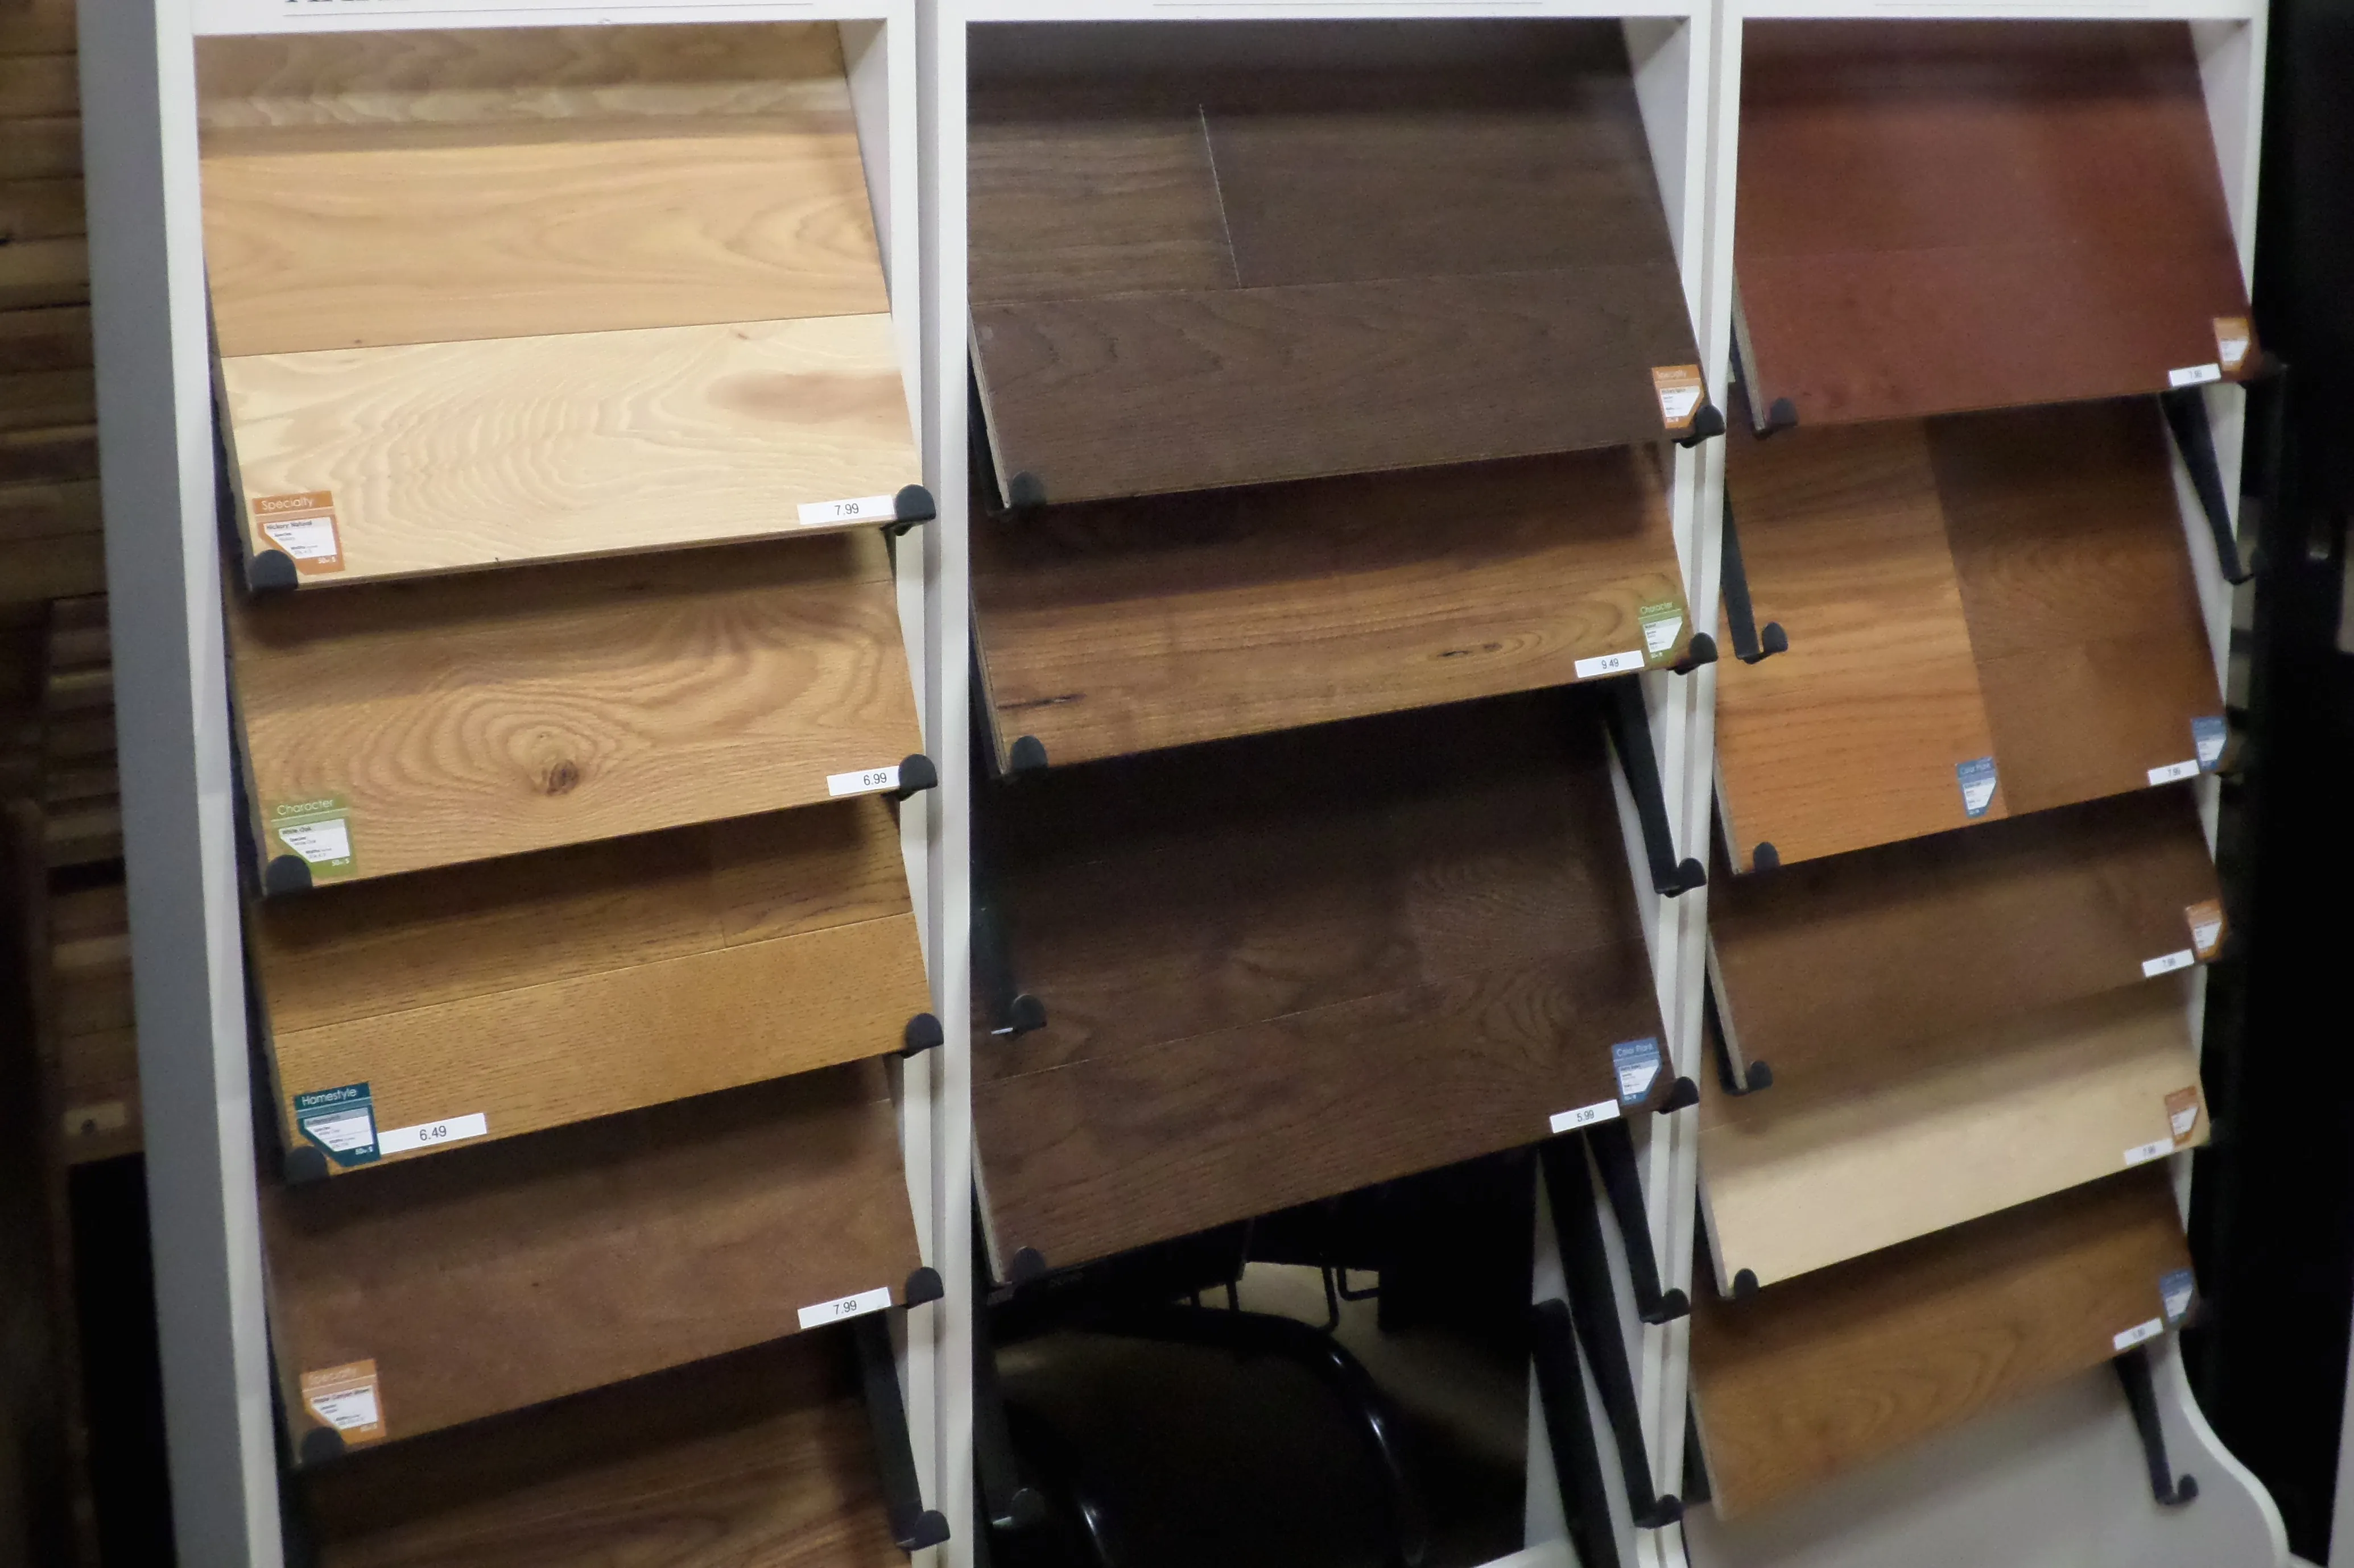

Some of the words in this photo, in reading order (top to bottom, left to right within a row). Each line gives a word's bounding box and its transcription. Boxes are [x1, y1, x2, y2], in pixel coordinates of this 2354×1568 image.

[261, 497, 314, 511] Specialty
[834, 503, 859, 516] 7.99
[1601, 658, 1620, 669] 9.49
[864, 772, 887, 786] 6.99
[277, 799, 333, 816] Character
[302, 1087, 357, 1106] Homestyle
[1577, 1110, 1595, 1122] 5.99
[419, 1126, 447, 1141] 6.49
[833, 1300, 857, 1315] 7.99
